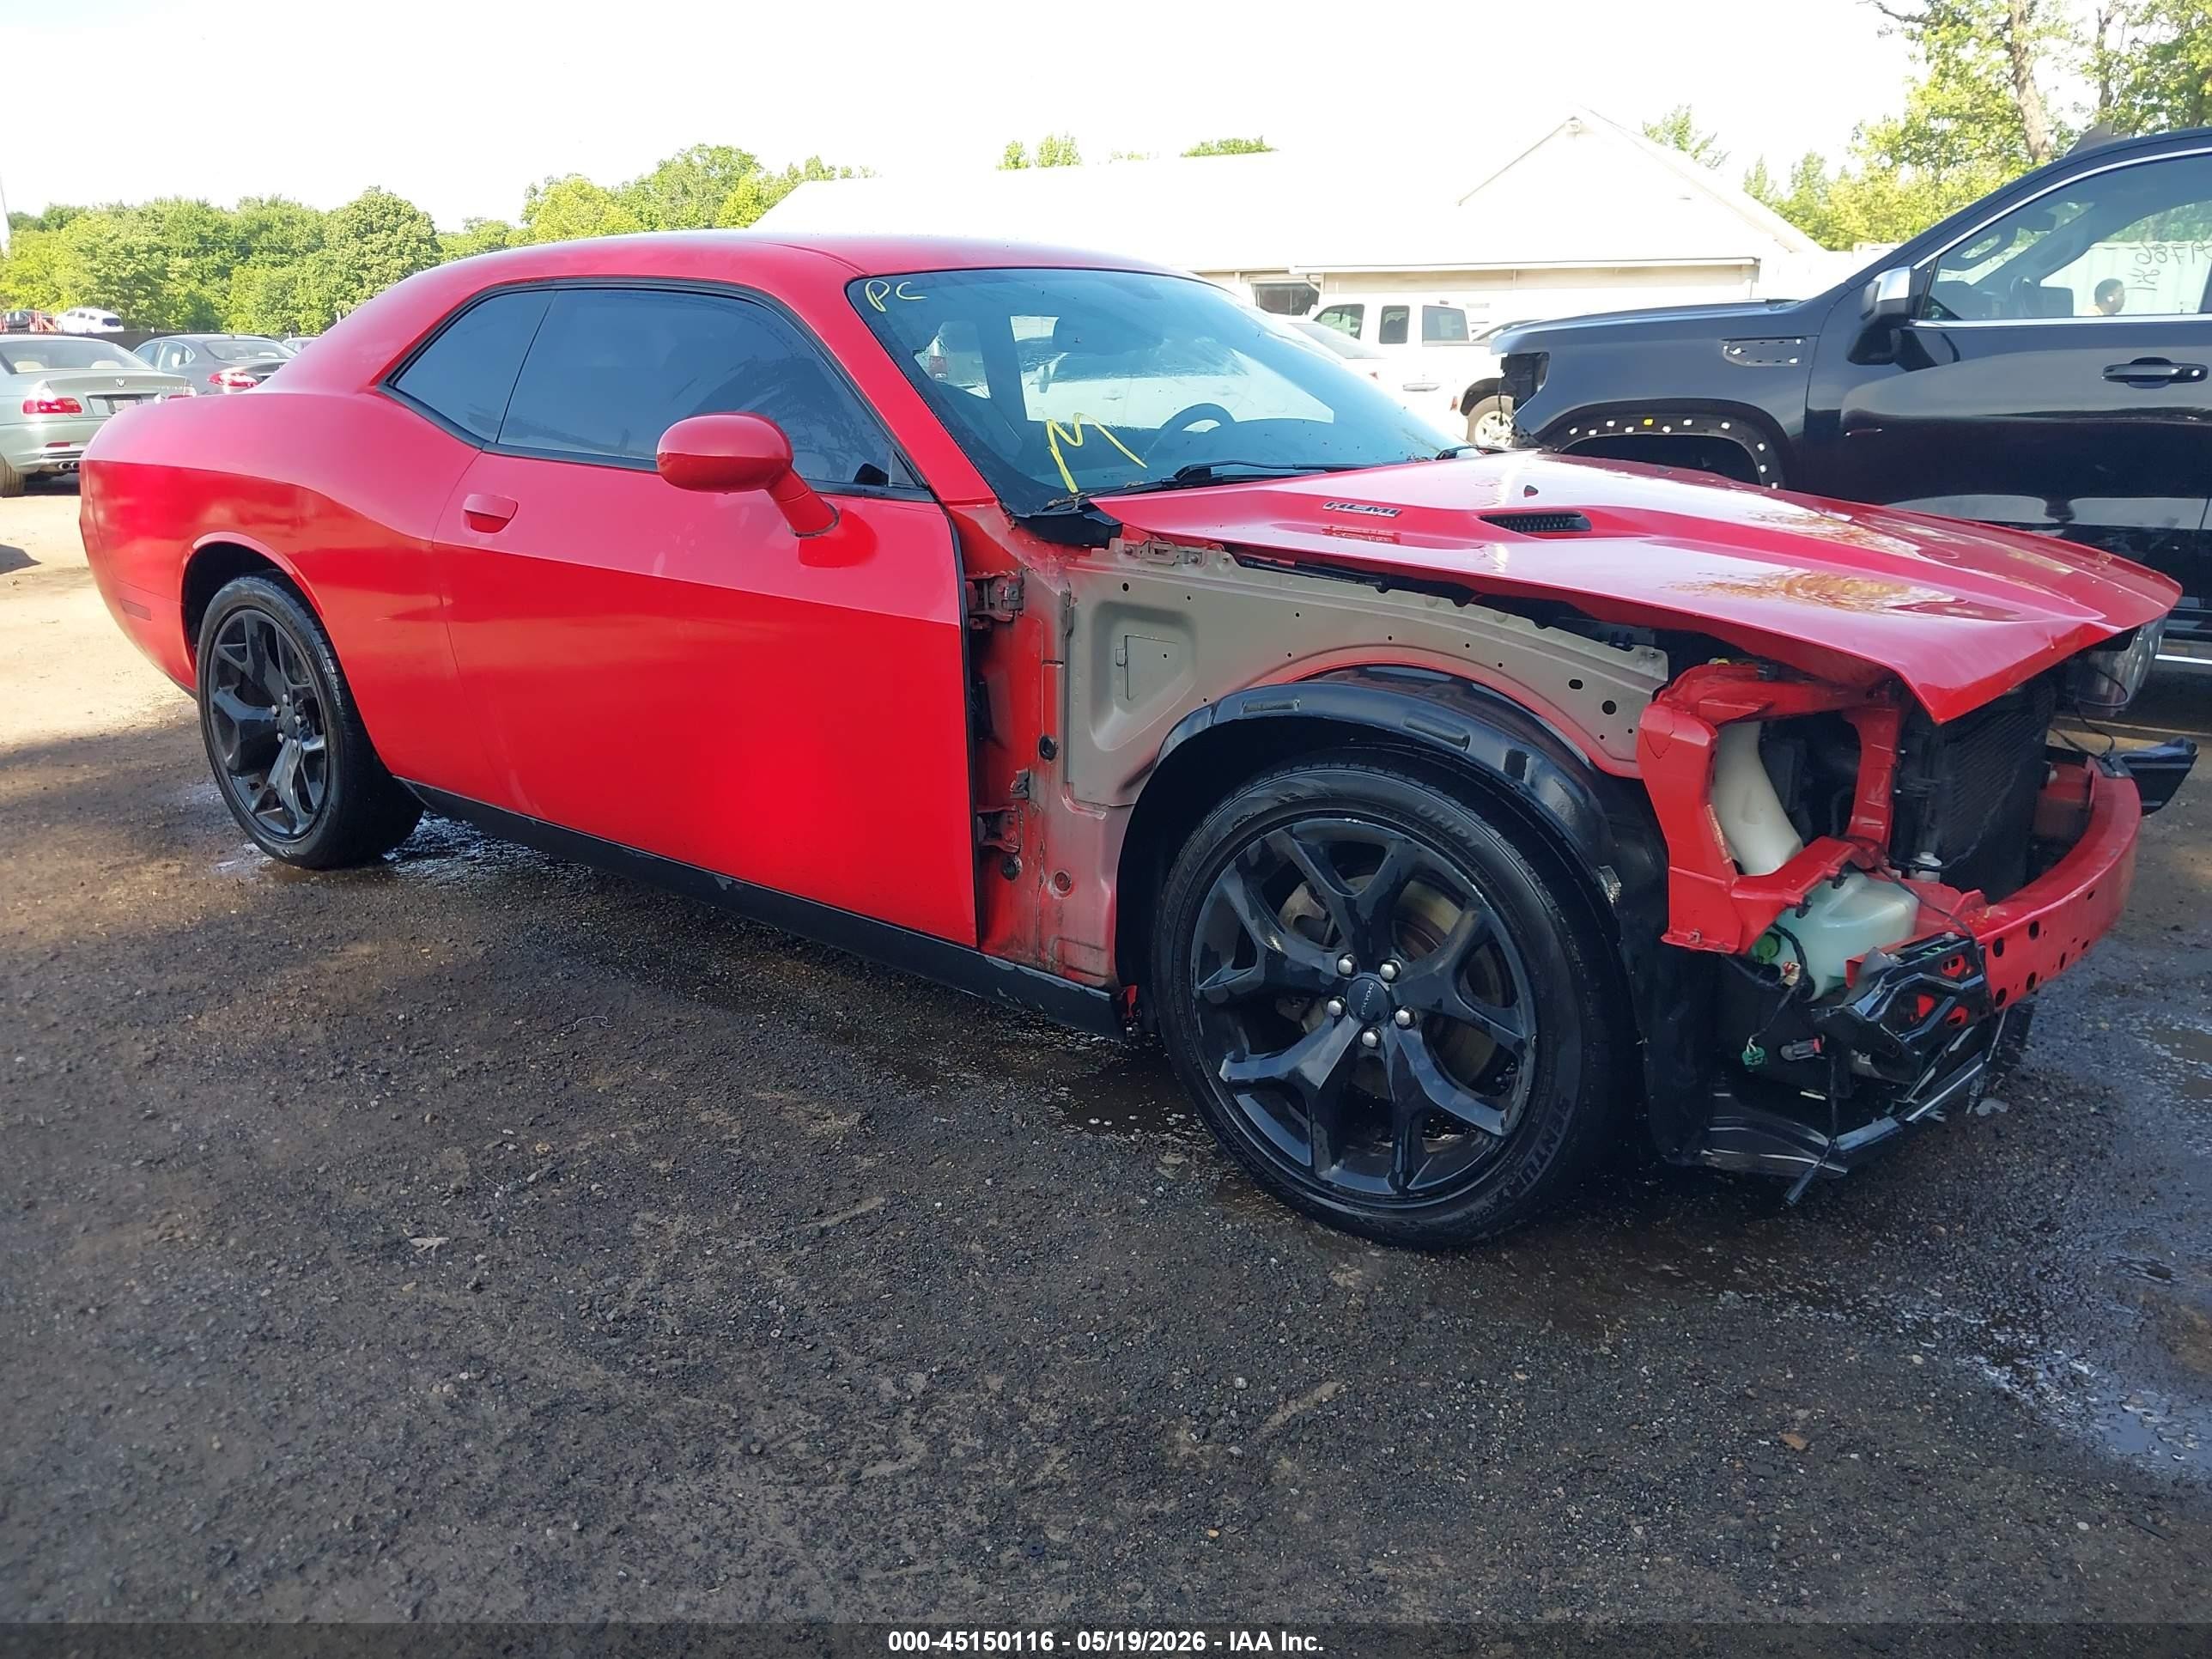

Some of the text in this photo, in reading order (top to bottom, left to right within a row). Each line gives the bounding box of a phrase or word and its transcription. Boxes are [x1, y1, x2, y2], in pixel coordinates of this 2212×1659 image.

[865, 280, 927, 313] PC
[1045, 411, 1148, 494] M
[1322, 501, 1401, 518] HEMI
[1414, 803, 1485, 849] UHPT
